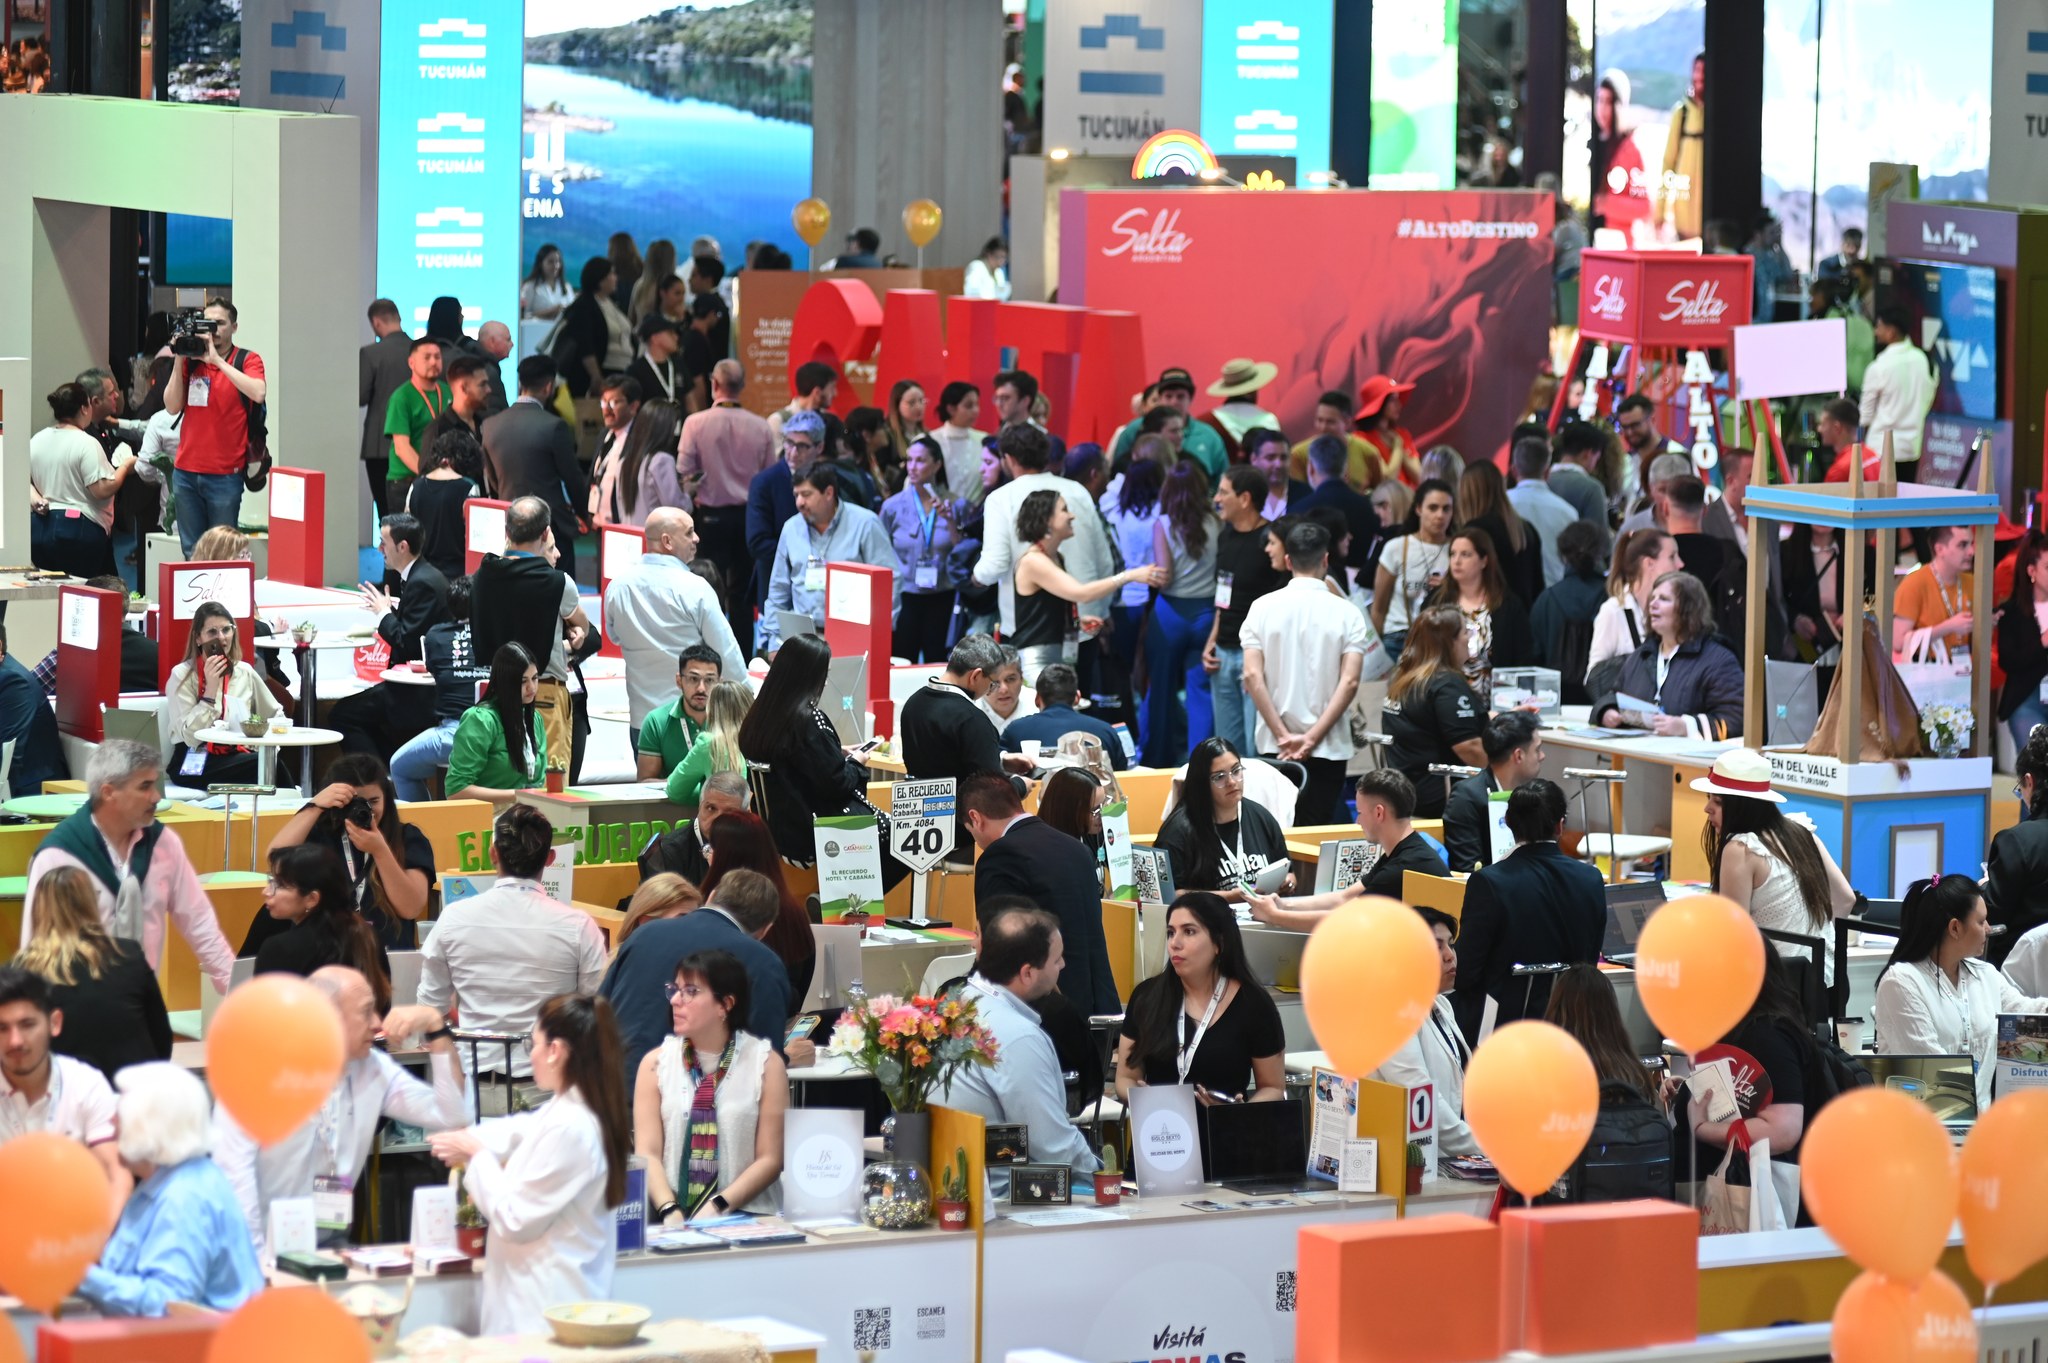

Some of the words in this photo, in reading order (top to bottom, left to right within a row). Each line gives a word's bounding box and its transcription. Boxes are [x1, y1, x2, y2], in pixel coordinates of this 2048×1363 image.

[419, 63, 486, 79] TUCUMÁN
[417, 158, 485, 174] TUCUMÁN
[1102, 207, 1194, 256] Salta
[415, 251, 484, 268] TUCUMÁN
[1590, 274, 1627, 314] Salta
[1659, 280, 1728, 321] Salta
[1682, 351, 1718, 470] ALTO
[357, 641, 391, 663] Salta
[1786, 760, 1804, 773] DEL
[1807, 763, 1837, 778] VALLE
[1786, 773, 1798, 782] DEL
[1800, 776, 1829, 787] TURISMO
[897, 787, 907, 799] EL
[908, 783, 952, 797] RECUERDO
[893, 802, 912, 810] Hotel
[912, 802, 918, 810] y
[893, 808, 922, 818] Cabañas
[896, 821, 912, 830] Km.
[914, 818, 935, 827] 4084
[900, 828, 943, 856] 40
[1416, 1095, 1425, 1123] 1
[1153, 1323, 1207, 1350] Visitá
